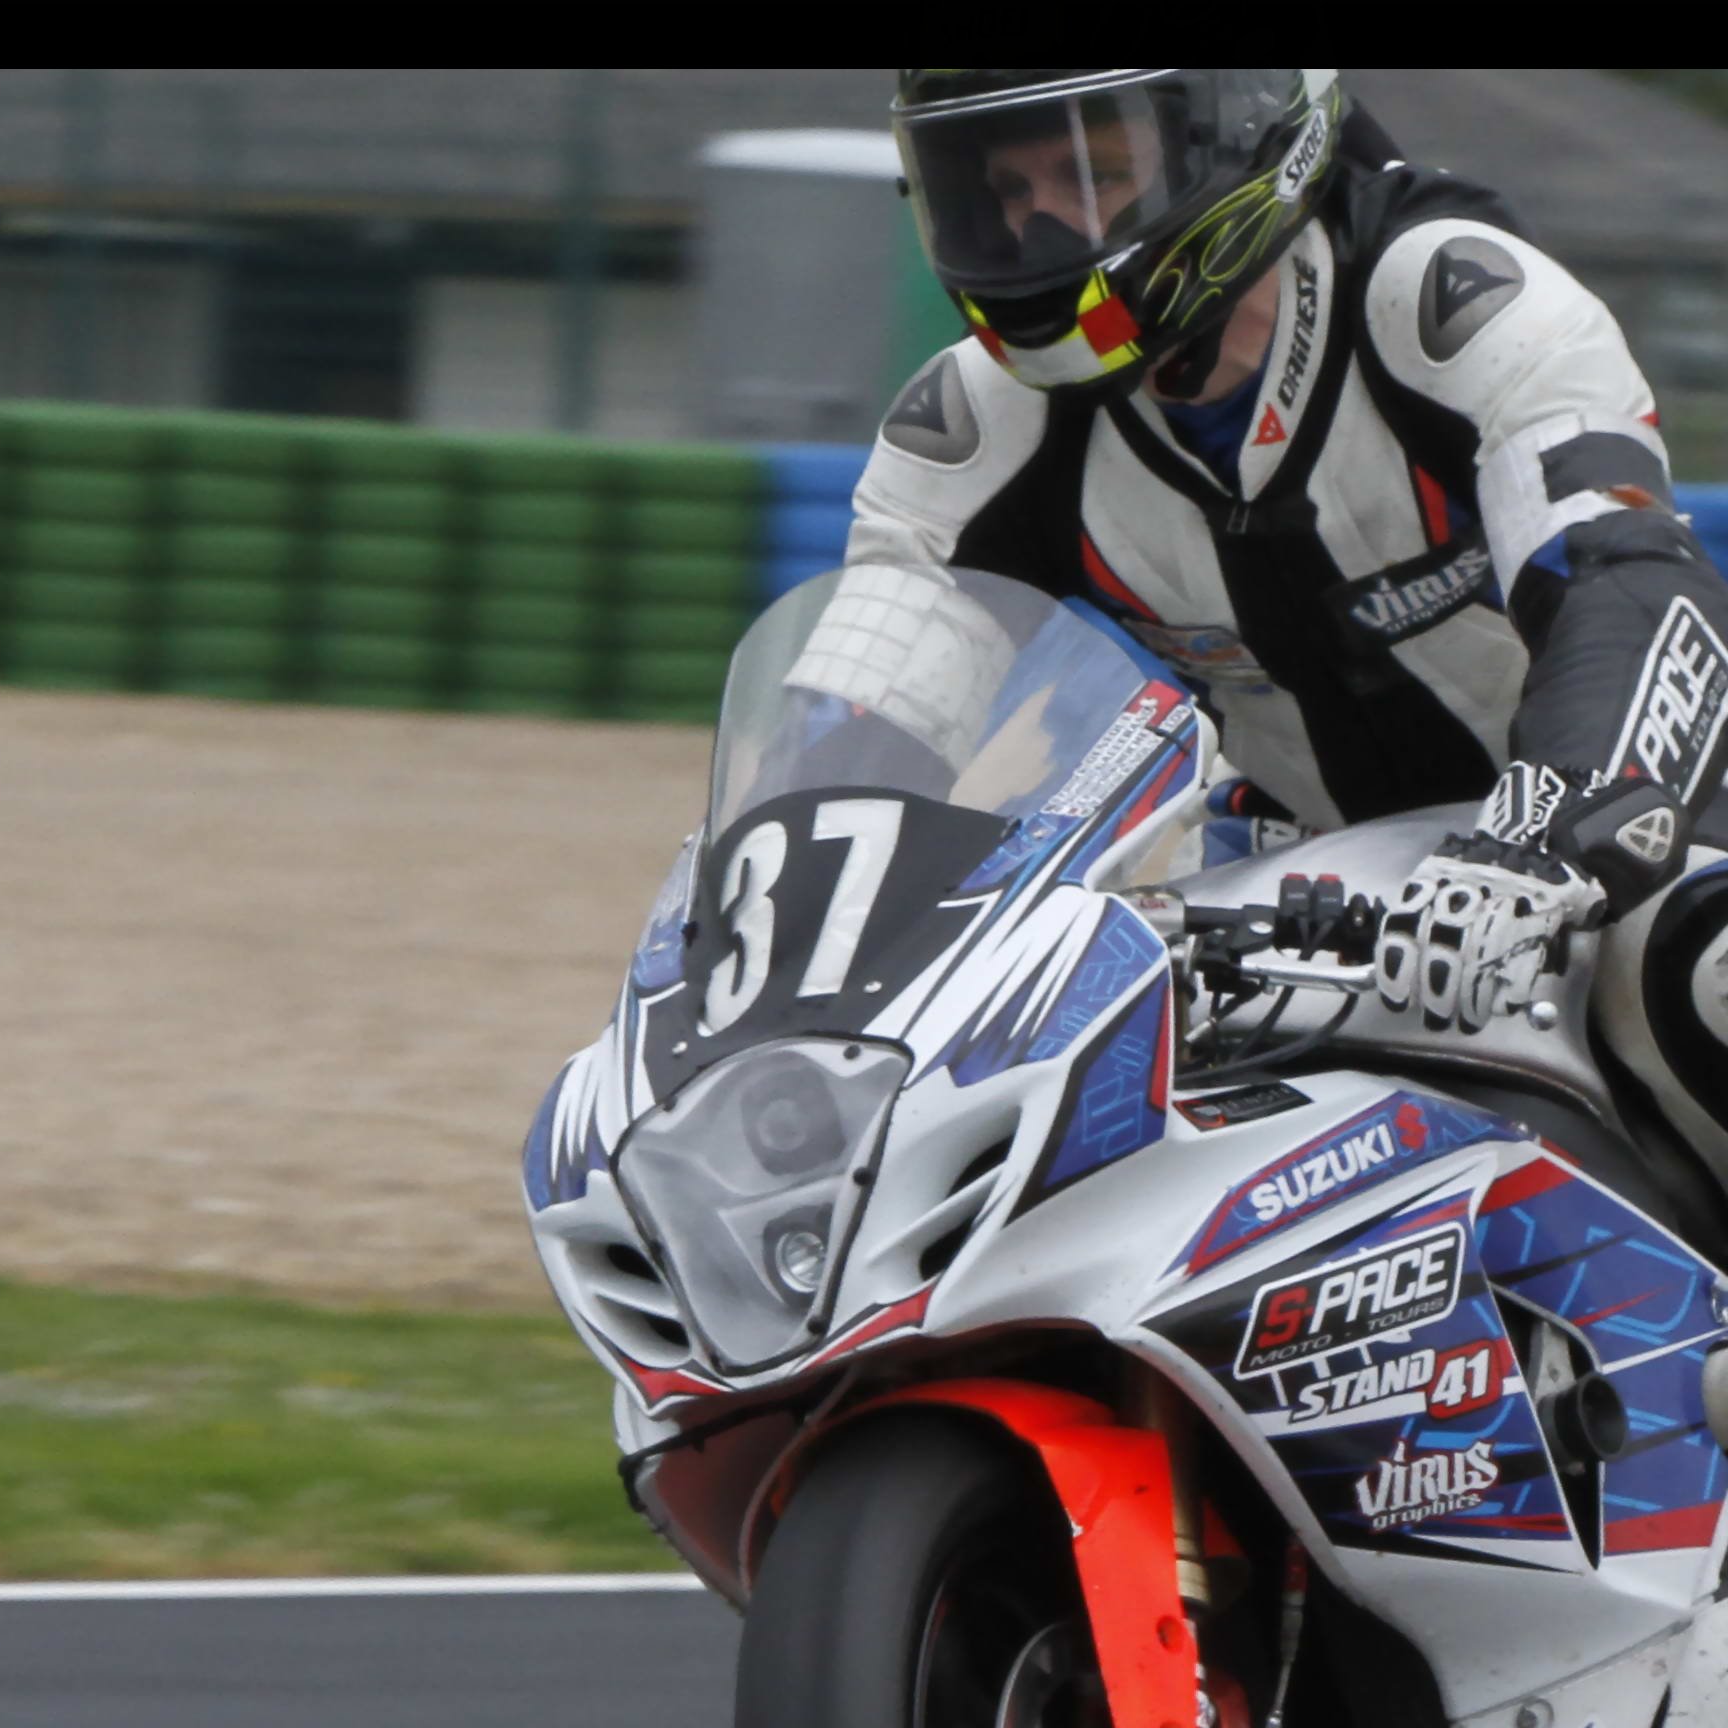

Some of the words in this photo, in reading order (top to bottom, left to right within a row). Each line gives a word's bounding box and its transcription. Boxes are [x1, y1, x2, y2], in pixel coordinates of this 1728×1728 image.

[1626, 613, 1718, 785] PACE
[697, 798, 905, 1037] 37
[1251, 1122, 1396, 1222] SUZUKI
[1248, 1333, 1333, 1368] MOTO
[1368, 1296, 1445, 1332] TOURS
[1289, 1348, 1437, 1424] STAND
[1430, 1347, 1490, 1407] 41
